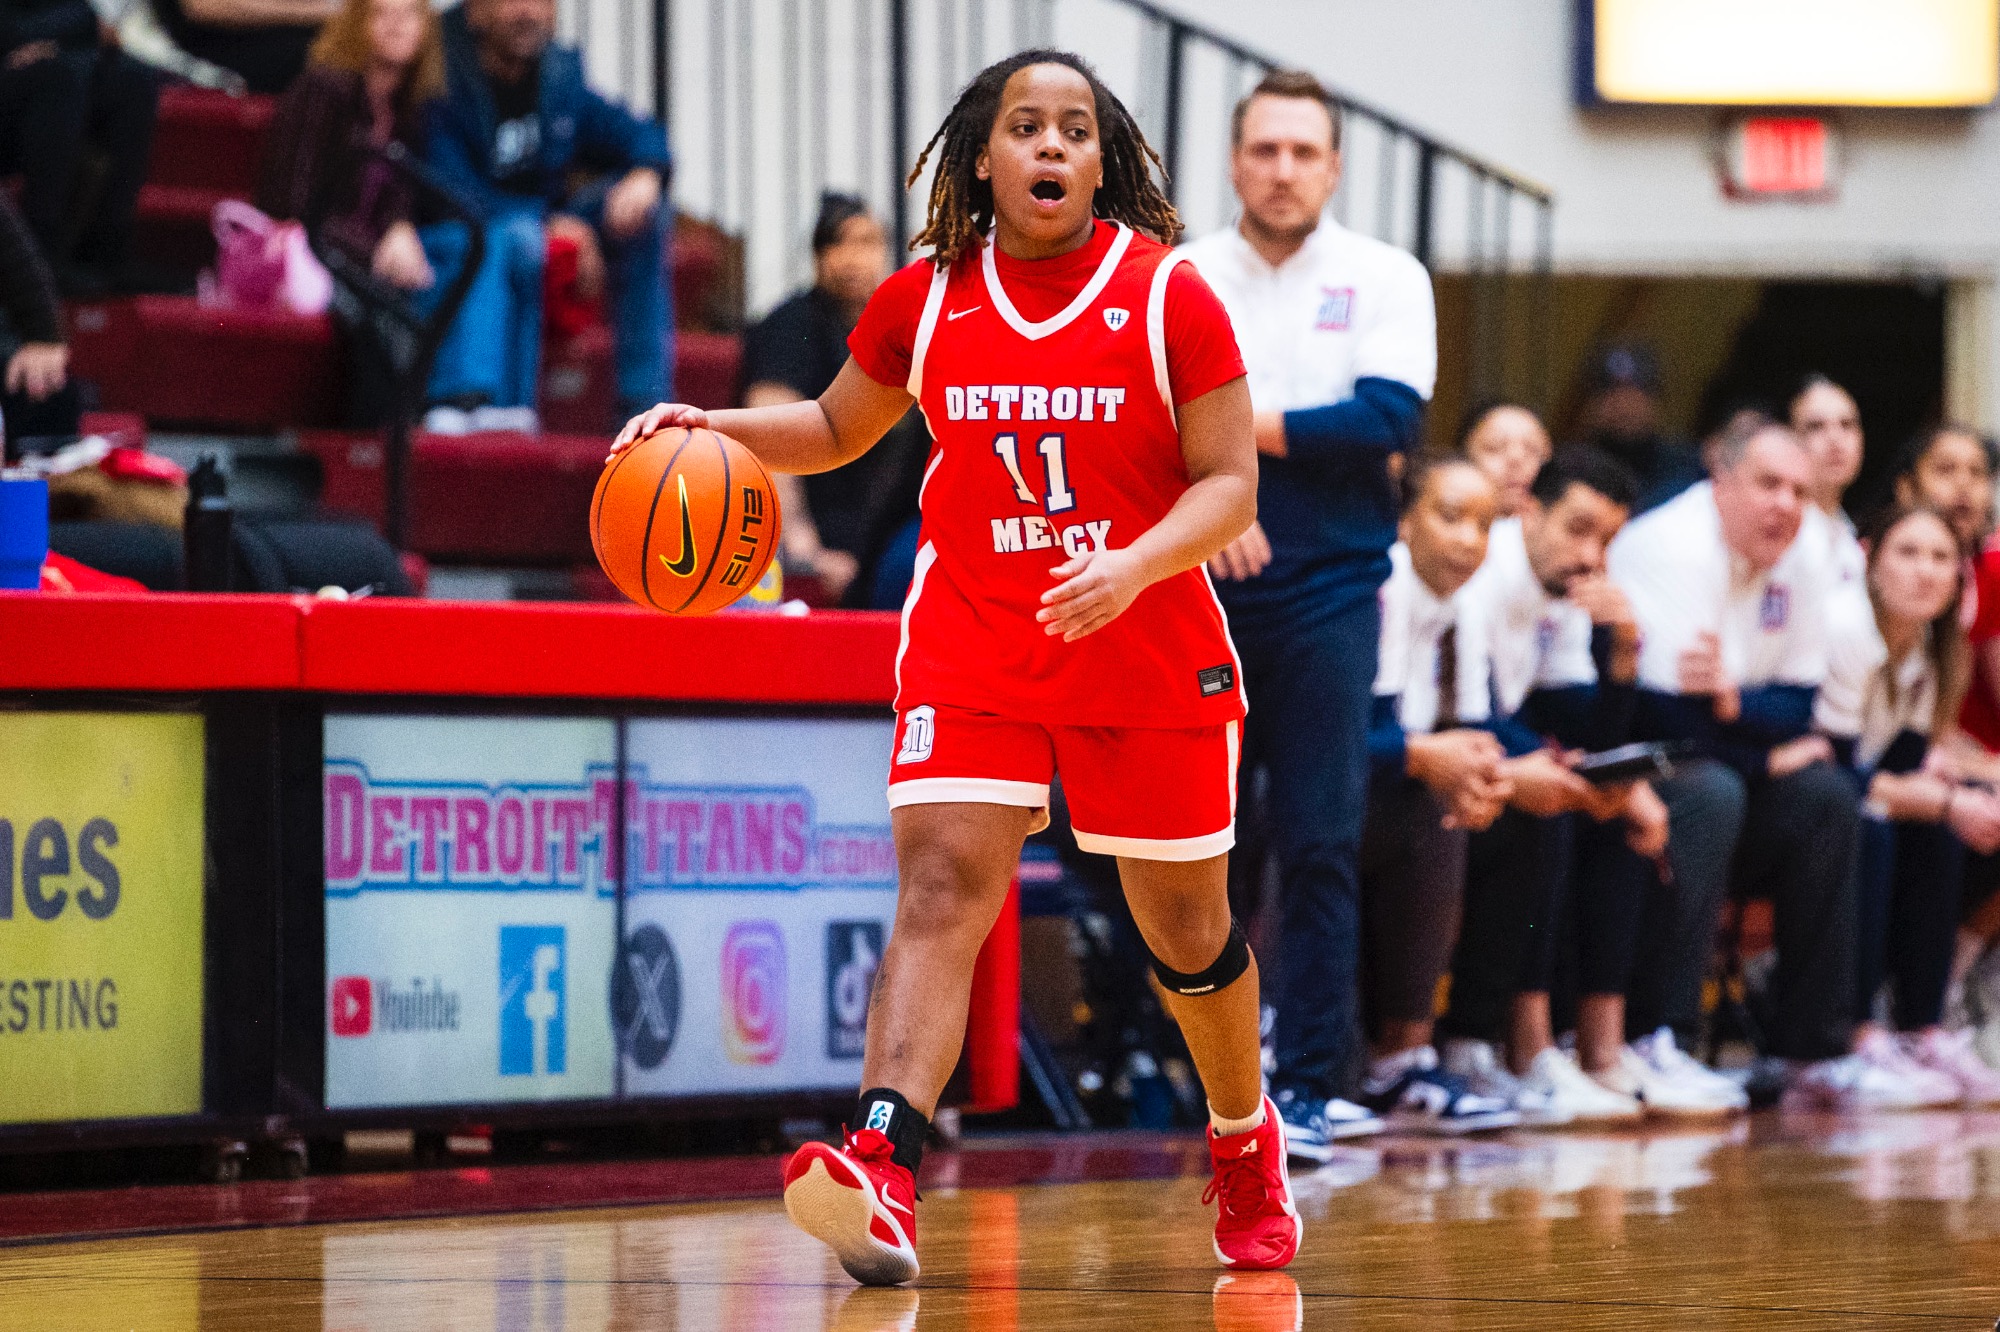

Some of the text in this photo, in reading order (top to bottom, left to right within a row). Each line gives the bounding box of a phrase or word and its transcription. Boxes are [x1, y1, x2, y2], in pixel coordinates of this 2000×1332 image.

[945, 385, 1126, 422] DETROIT
[992, 431, 1077, 516] 11
[719, 486, 763, 587] ELITE
[0, 816, 121, 922] es
